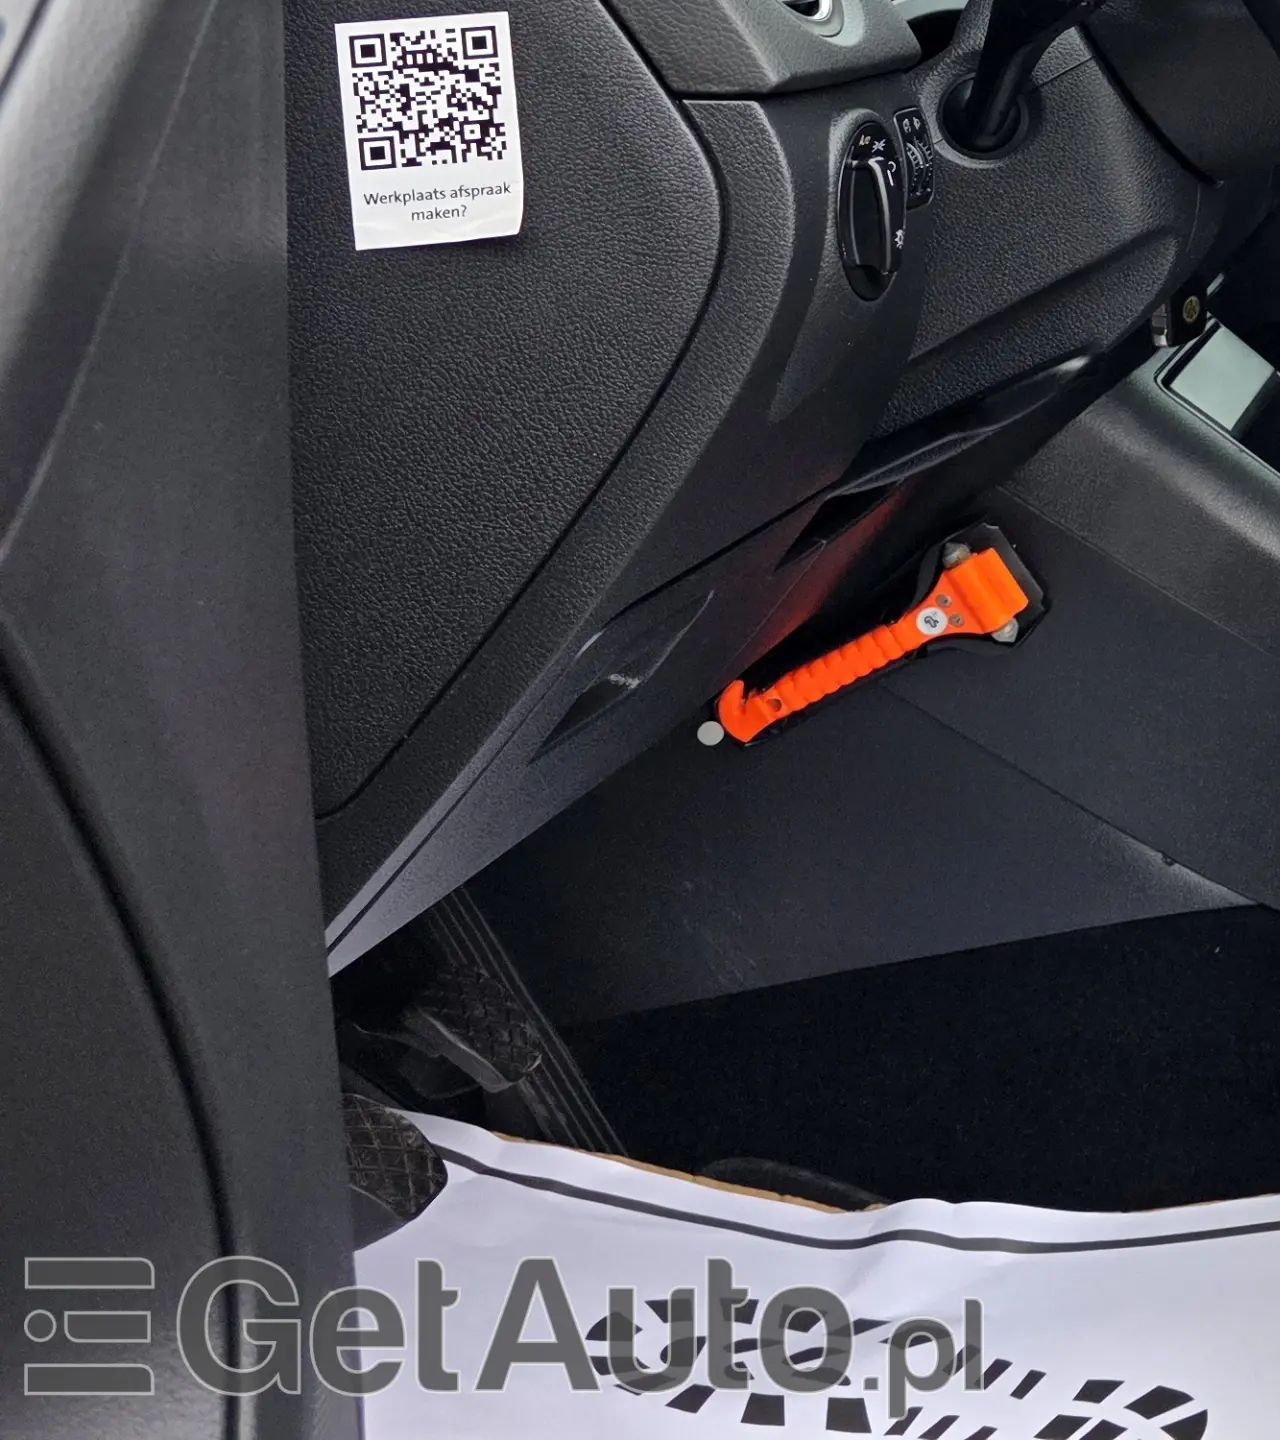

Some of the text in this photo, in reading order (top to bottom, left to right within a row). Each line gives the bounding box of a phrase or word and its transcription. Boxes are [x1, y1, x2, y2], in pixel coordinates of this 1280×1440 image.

[363, 181, 512, 207] Werkplaats afspraak
[411, 204, 468, 222] maken?
